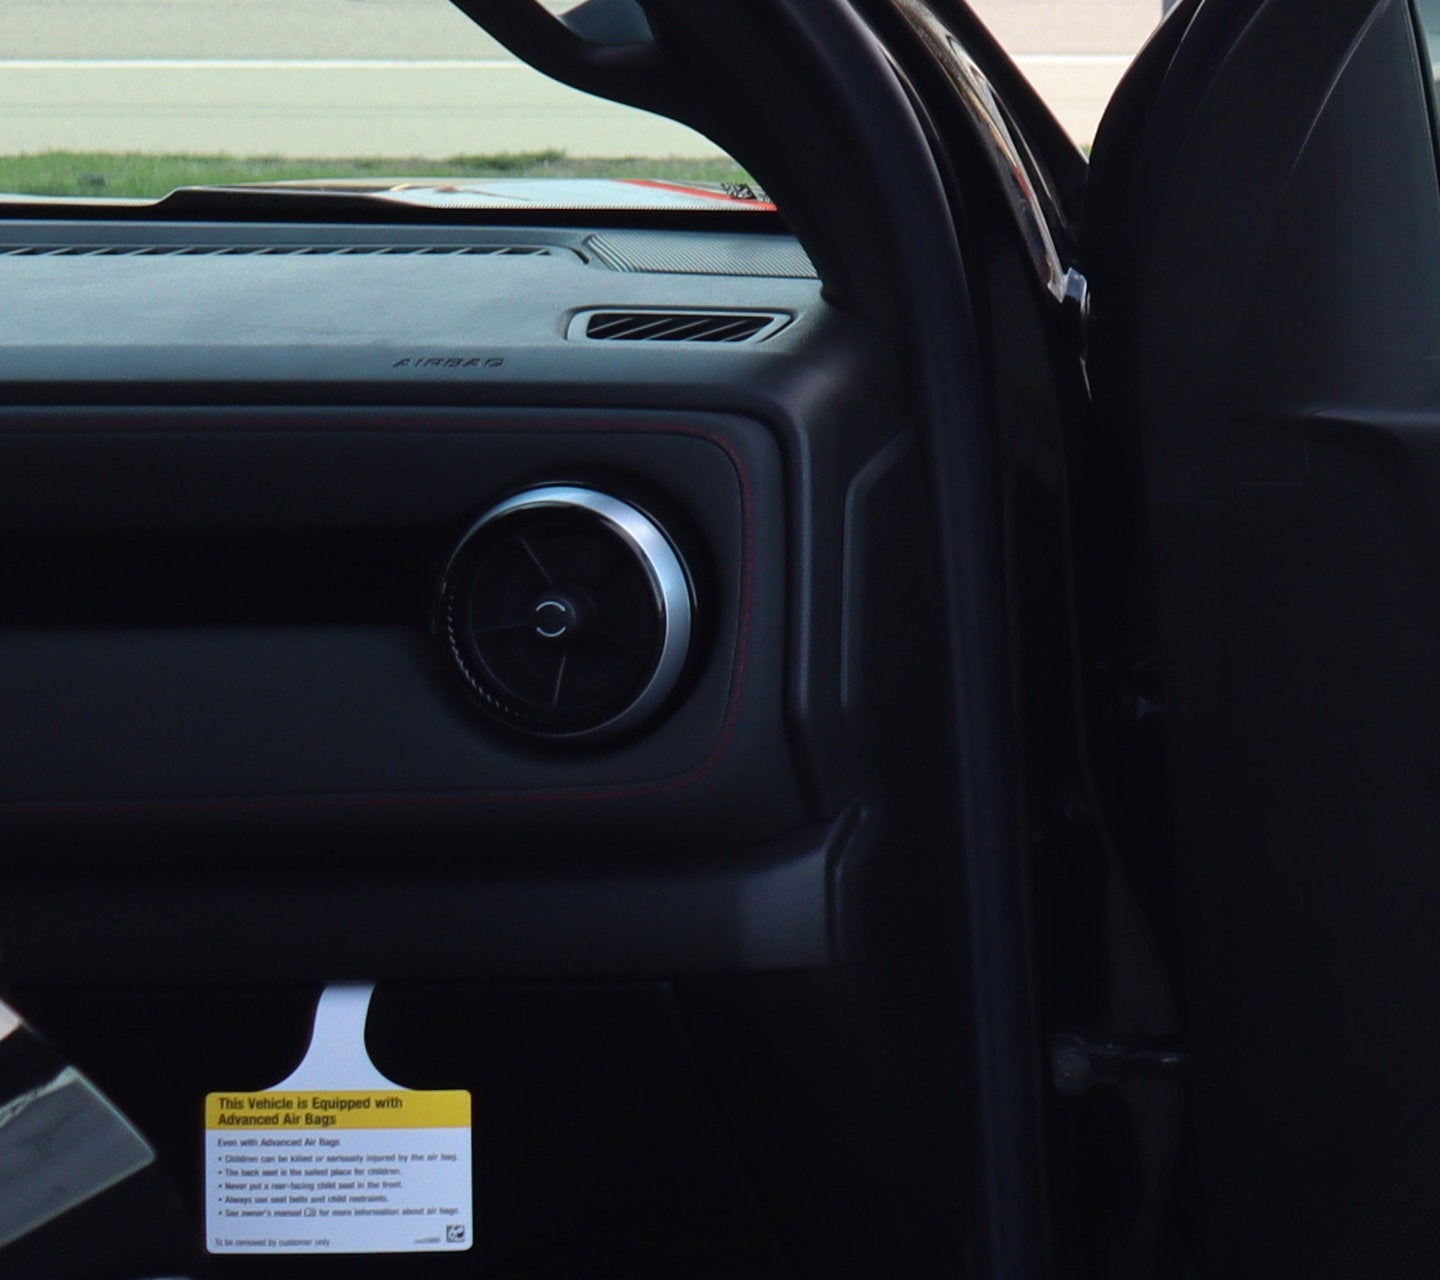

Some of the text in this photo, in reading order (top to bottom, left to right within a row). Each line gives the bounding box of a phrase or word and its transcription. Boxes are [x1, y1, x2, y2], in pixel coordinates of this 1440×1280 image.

[393, 358, 504, 368] AIRBAG
[218, 1097, 403, 1111] This Vehicle is Equipped with
[218, 1113, 337, 1127] Advanced Air Bags
[218, 1138, 340, 1147] Even with Advanced Air Bags
[225, 1154, 258, 1163] Children
